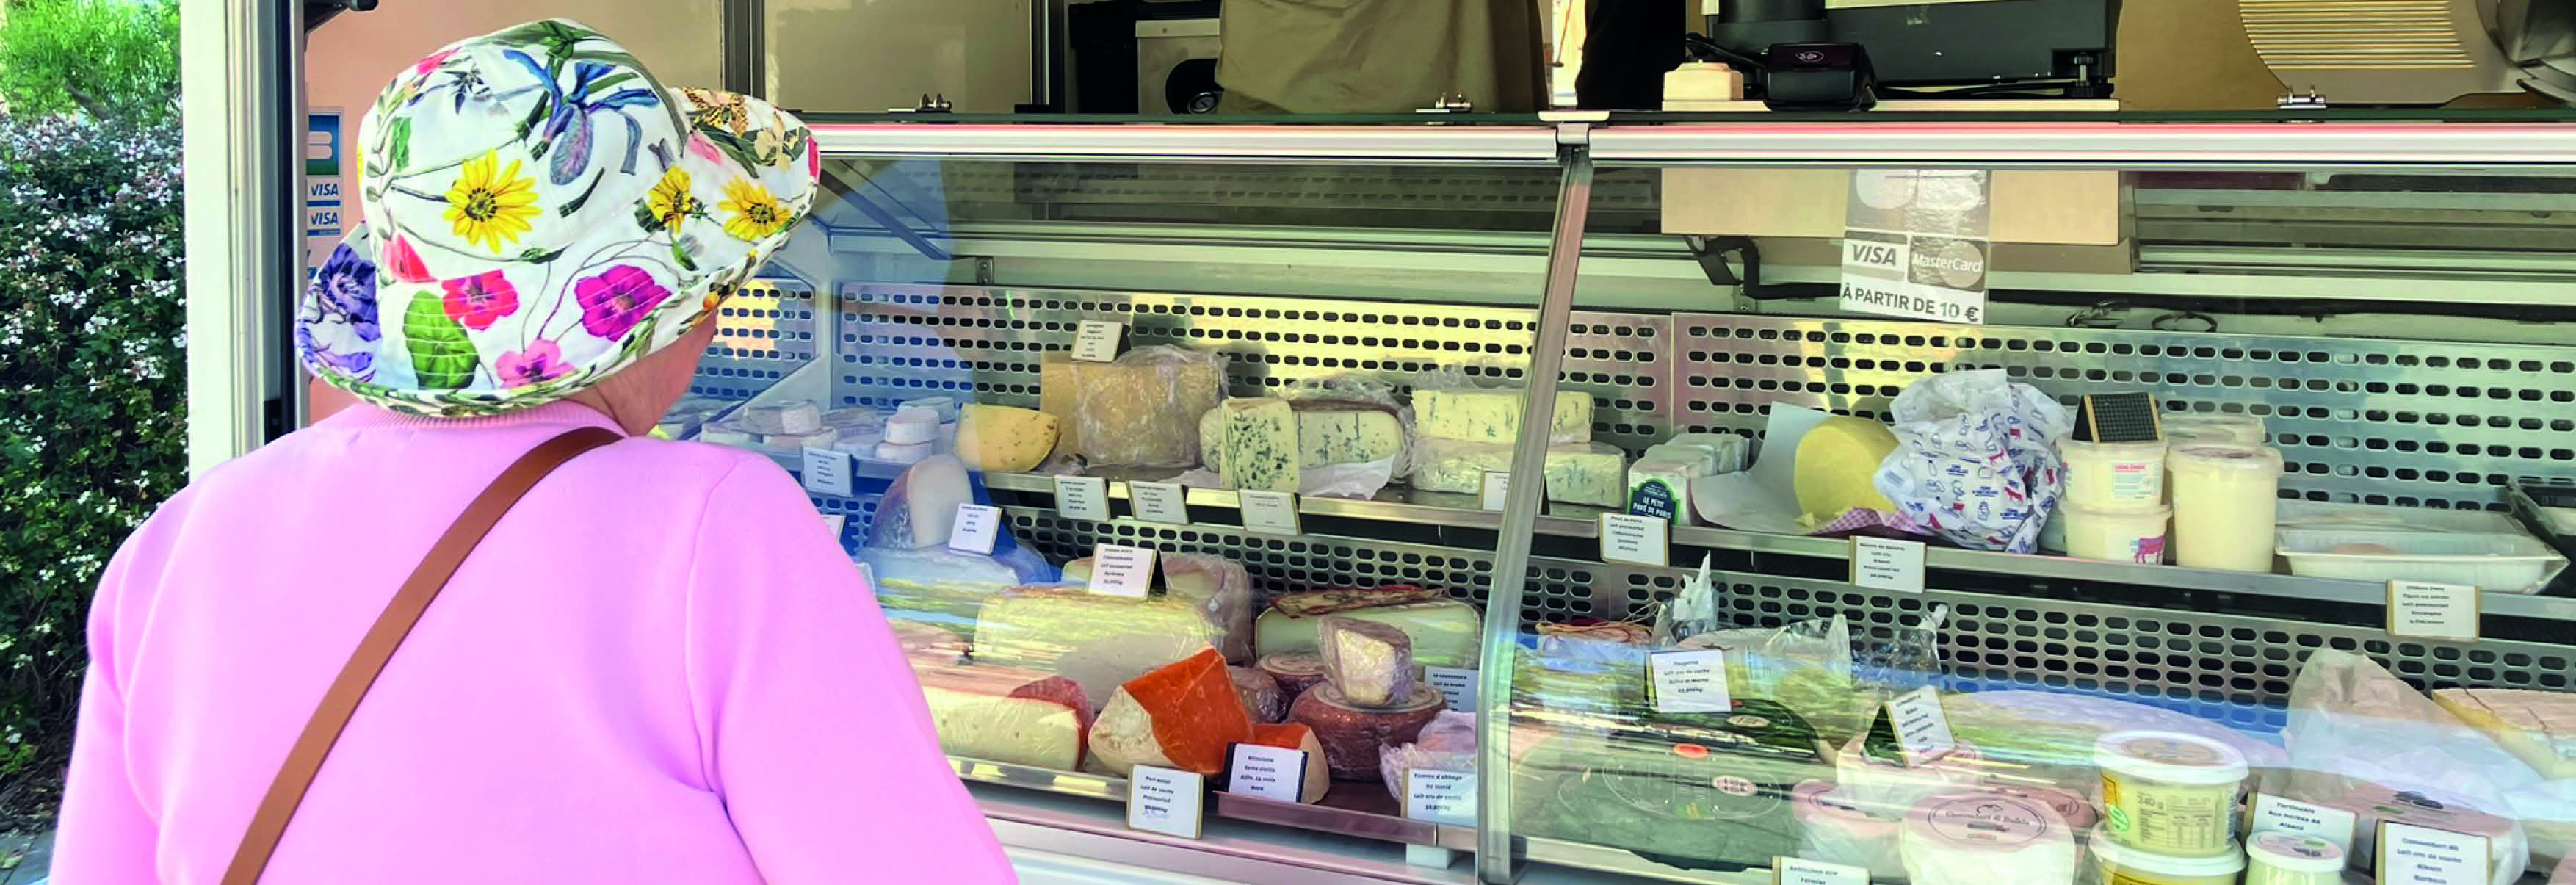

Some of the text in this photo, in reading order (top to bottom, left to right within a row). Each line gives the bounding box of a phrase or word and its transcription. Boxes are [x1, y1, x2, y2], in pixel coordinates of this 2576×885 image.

[310, 183, 339, 196] VISA
[310, 212, 339, 225] VISA
[1850, 244, 1897, 267] VISA
[1912, 252, 1983, 273] MasterCard
[1842, 285, 1979, 322] À PARTIR DE 10 €
[1643, 496, 1649, 505] LE
[1648, 506, 1655, 514] DE
